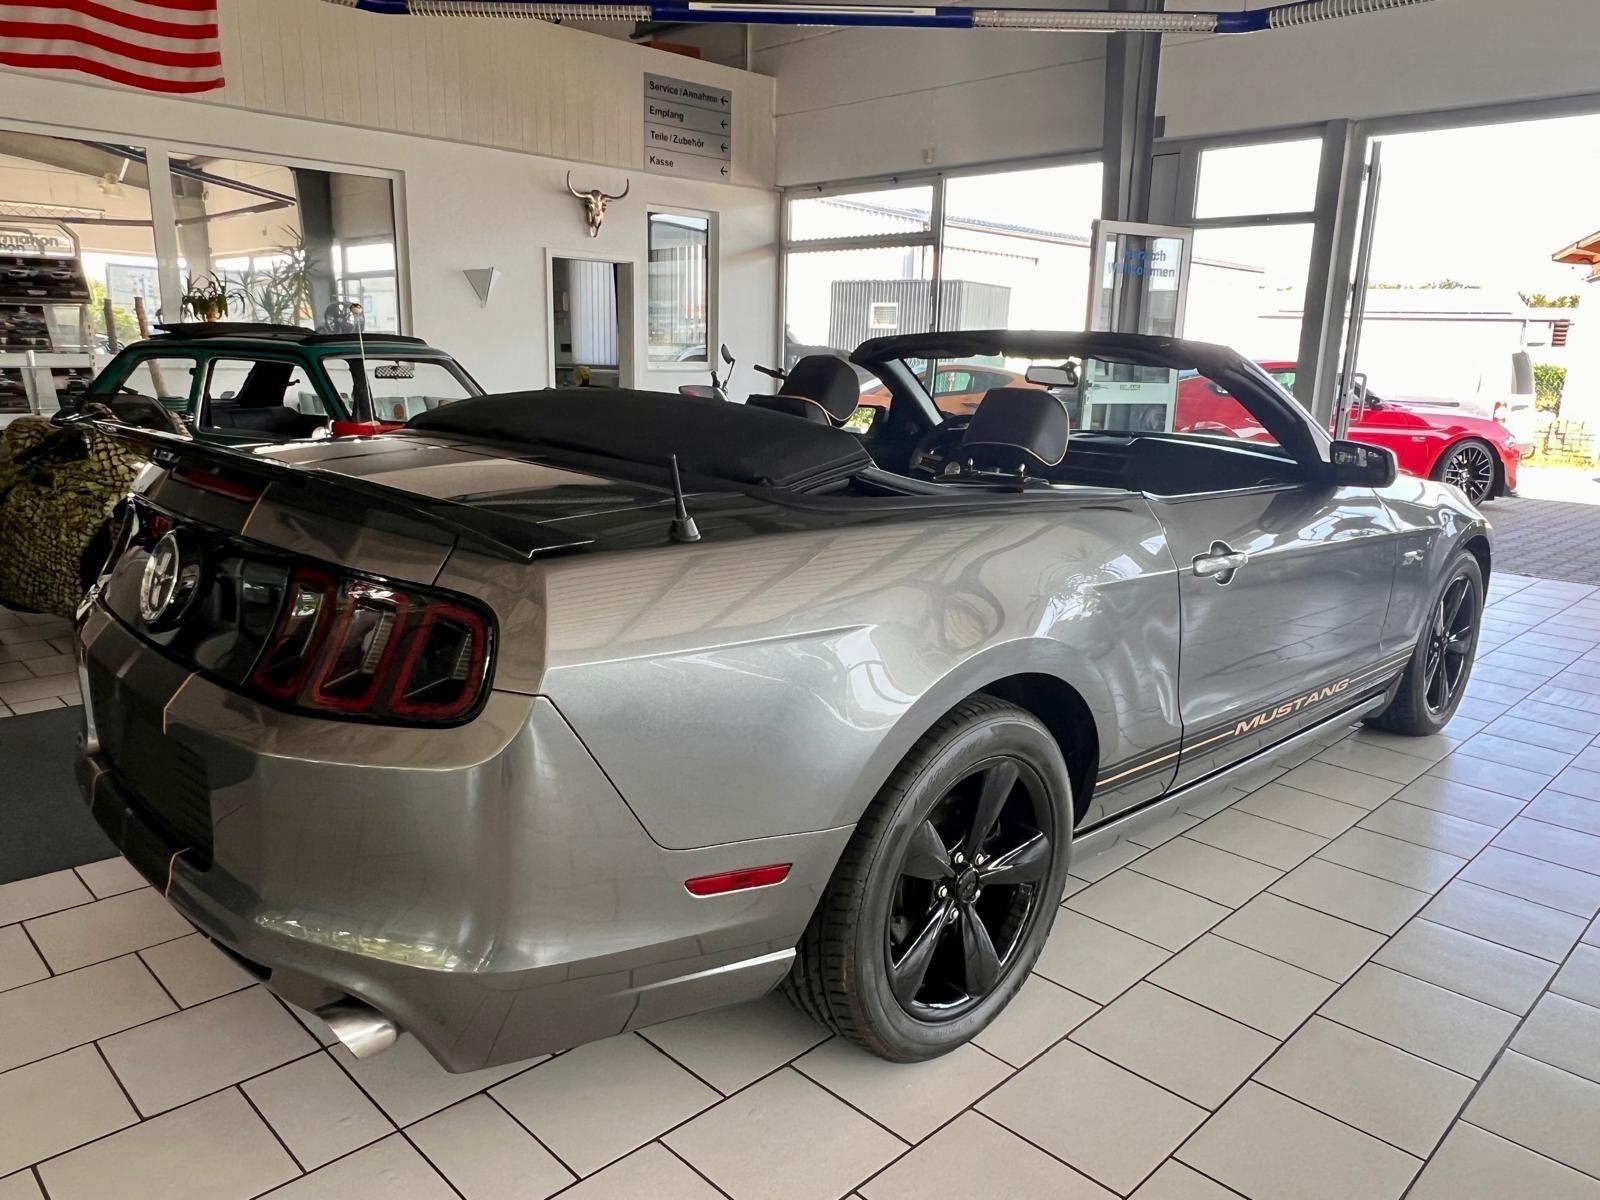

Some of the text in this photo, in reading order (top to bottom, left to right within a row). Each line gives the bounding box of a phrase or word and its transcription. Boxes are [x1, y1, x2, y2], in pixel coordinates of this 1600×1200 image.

[649, 105, 684, 122] Empfang
[649, 156, 674, 168] Kasse
[1234, 678, 1349, 736] MUSTANG
